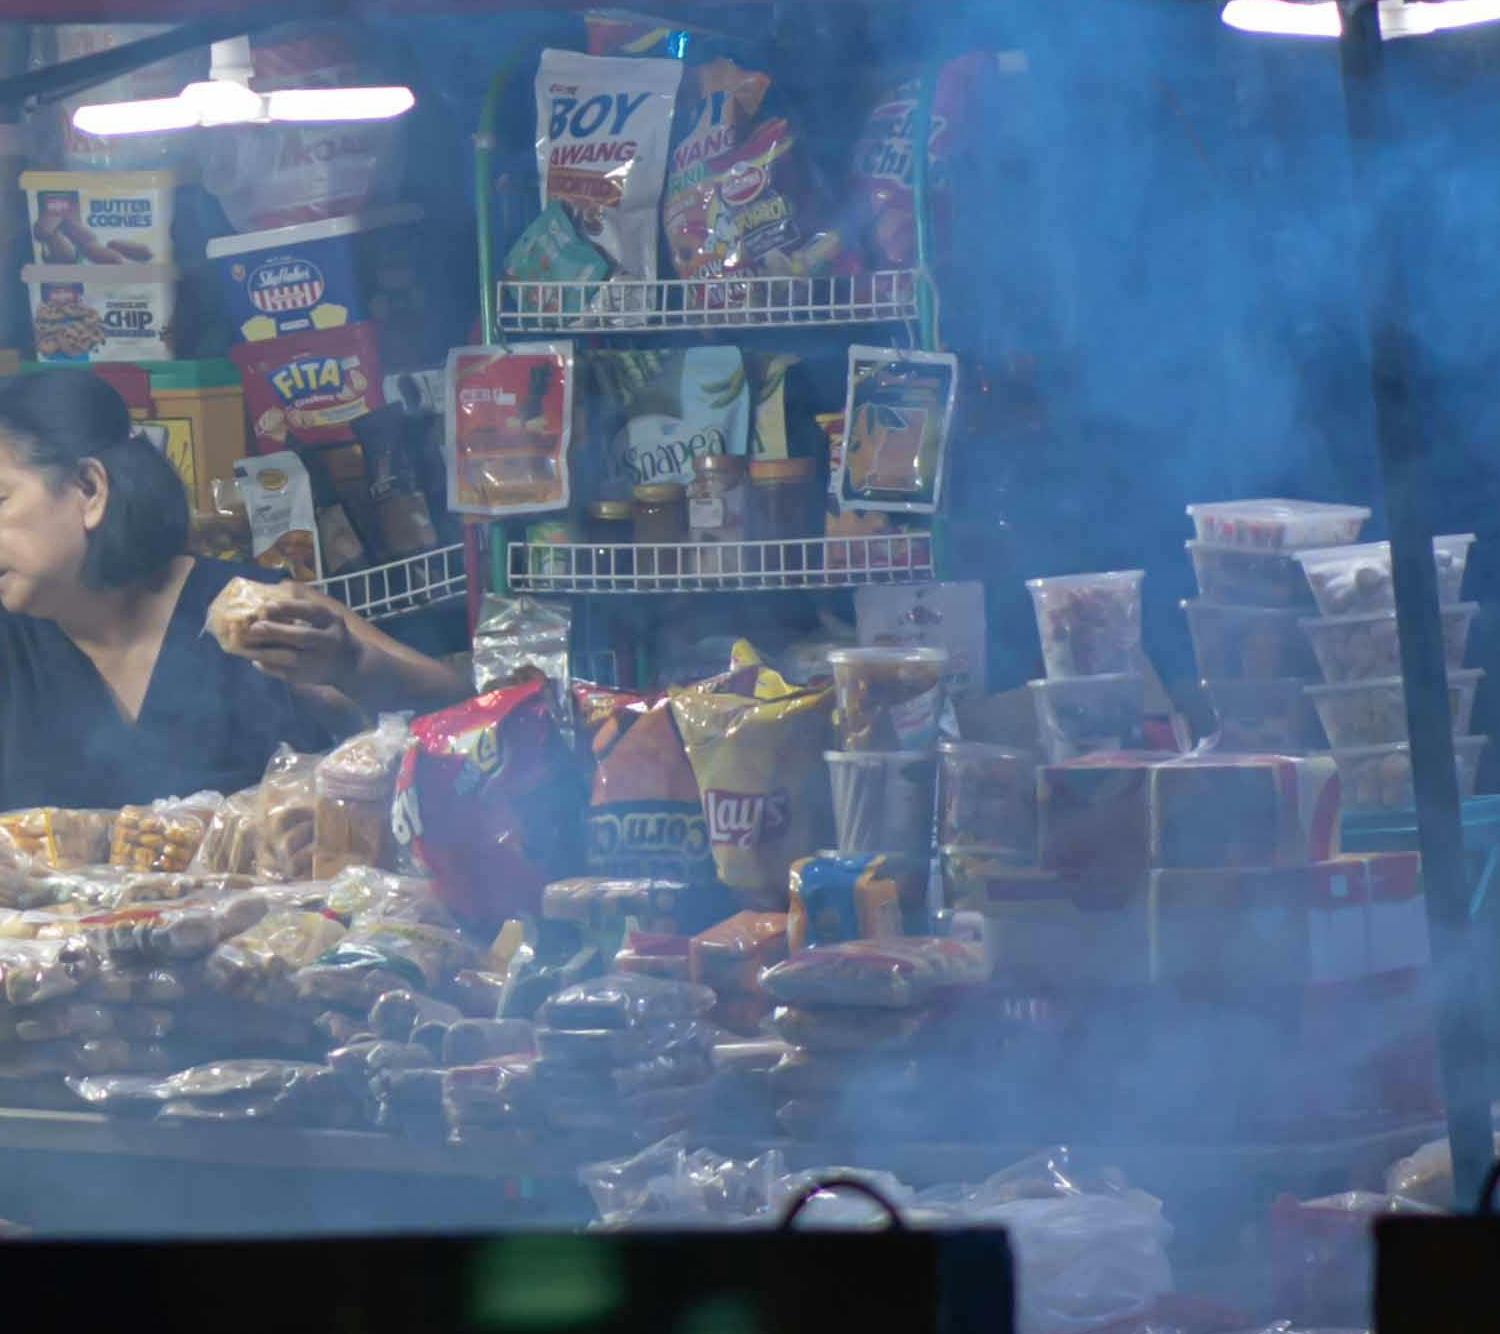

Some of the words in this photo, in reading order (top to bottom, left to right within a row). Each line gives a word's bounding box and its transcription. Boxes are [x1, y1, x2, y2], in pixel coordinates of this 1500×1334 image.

[549, 91, 650, 140] BOY
[103, 309, 153, 329] CHIP
[272, 358, 340, 400] FITA
